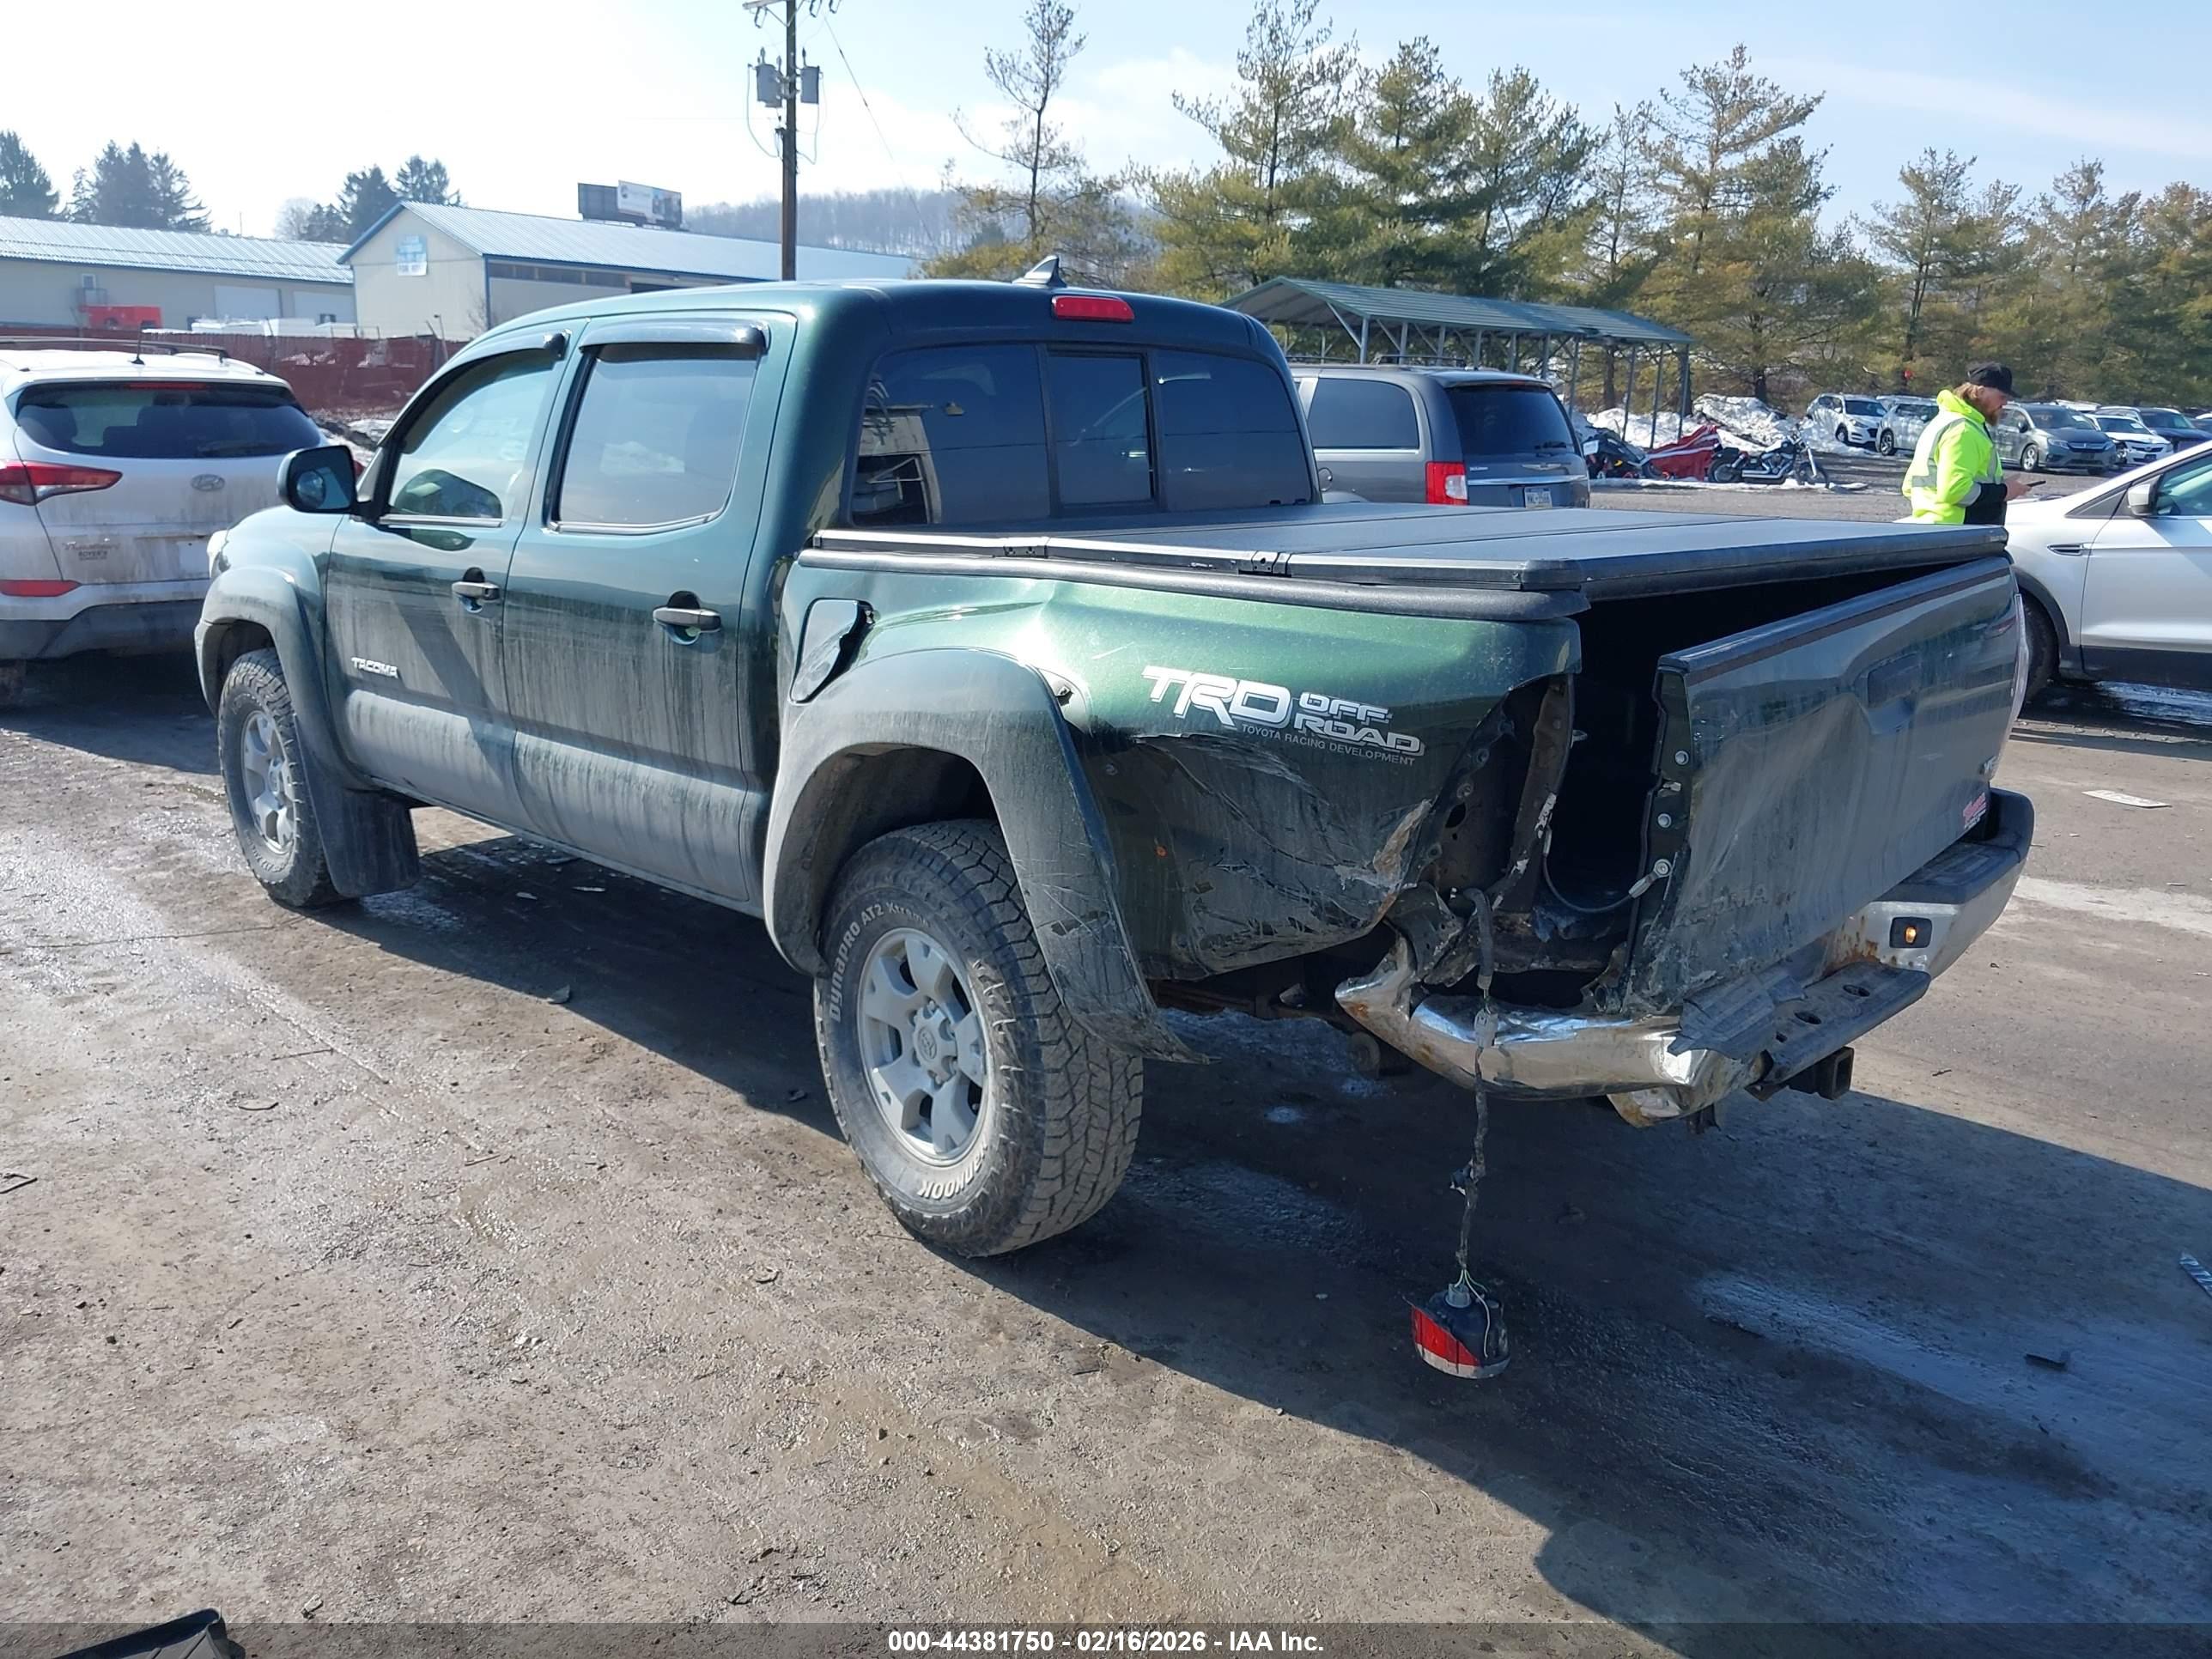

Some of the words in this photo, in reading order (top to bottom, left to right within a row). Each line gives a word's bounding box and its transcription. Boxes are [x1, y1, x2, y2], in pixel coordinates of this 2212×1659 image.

[350, 657, 398, 678] TACOMA
[1141, 665, 1292, 730] TRD
[1299, 692, 1392, 724] OFF
[1243, 724, 1281, 741] TOYOTA
[1285, 733, 1326, 750] RACING
[1329, 743, 1415, 766] DEVELOPMENT
[1294, 713, 1425, 756] ROAD
[861, 903, 884, 926] AT2
